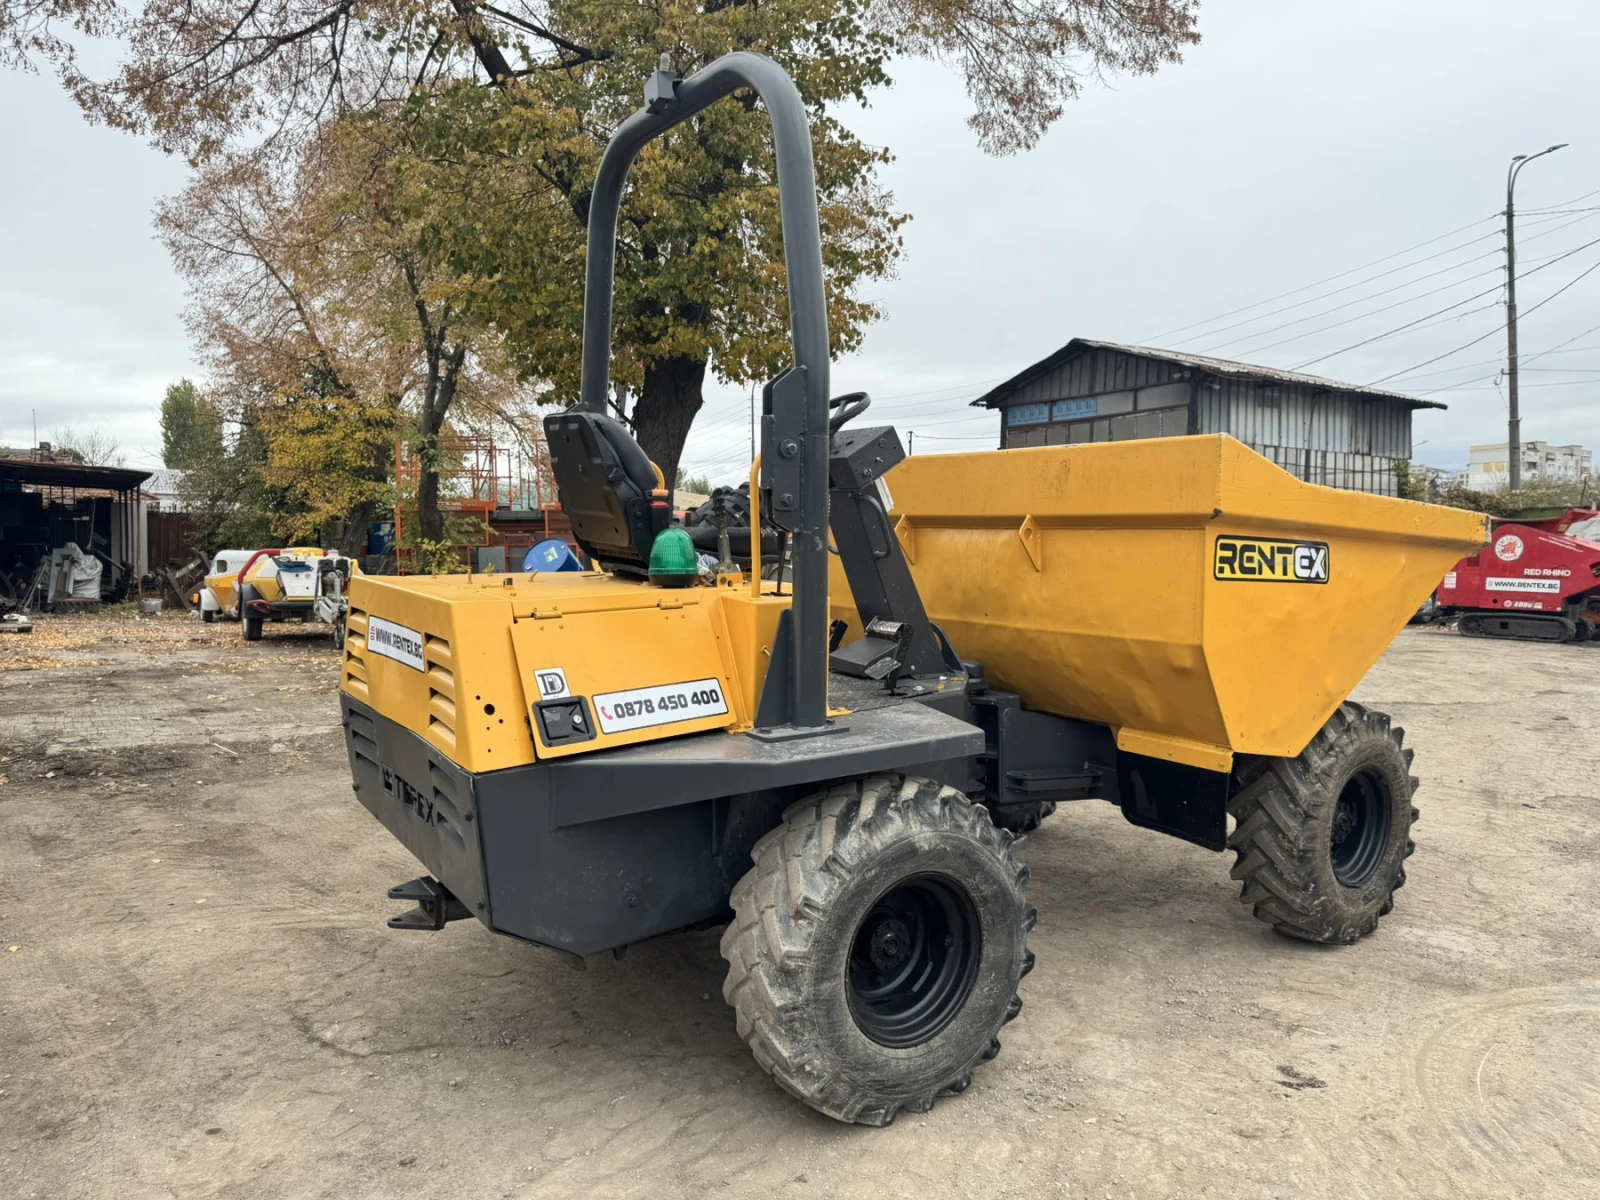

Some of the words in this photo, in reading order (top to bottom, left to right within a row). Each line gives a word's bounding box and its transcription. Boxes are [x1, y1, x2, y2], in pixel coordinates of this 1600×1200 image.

[1218, 542, 1326, 579] RENTEX
[1524, 568, 1541, 576] RED
[1542, 568, 1571, 577] RHINO
[1494, 581, 1559, 590] WWW.RENTEX.BG
[375, 627, 423, 660] WWW.RENTEX.BG
[613, 698, 656, 719] 0878
[657, 693, 689, 712] 450
[690, 688, 720, 706] 400
